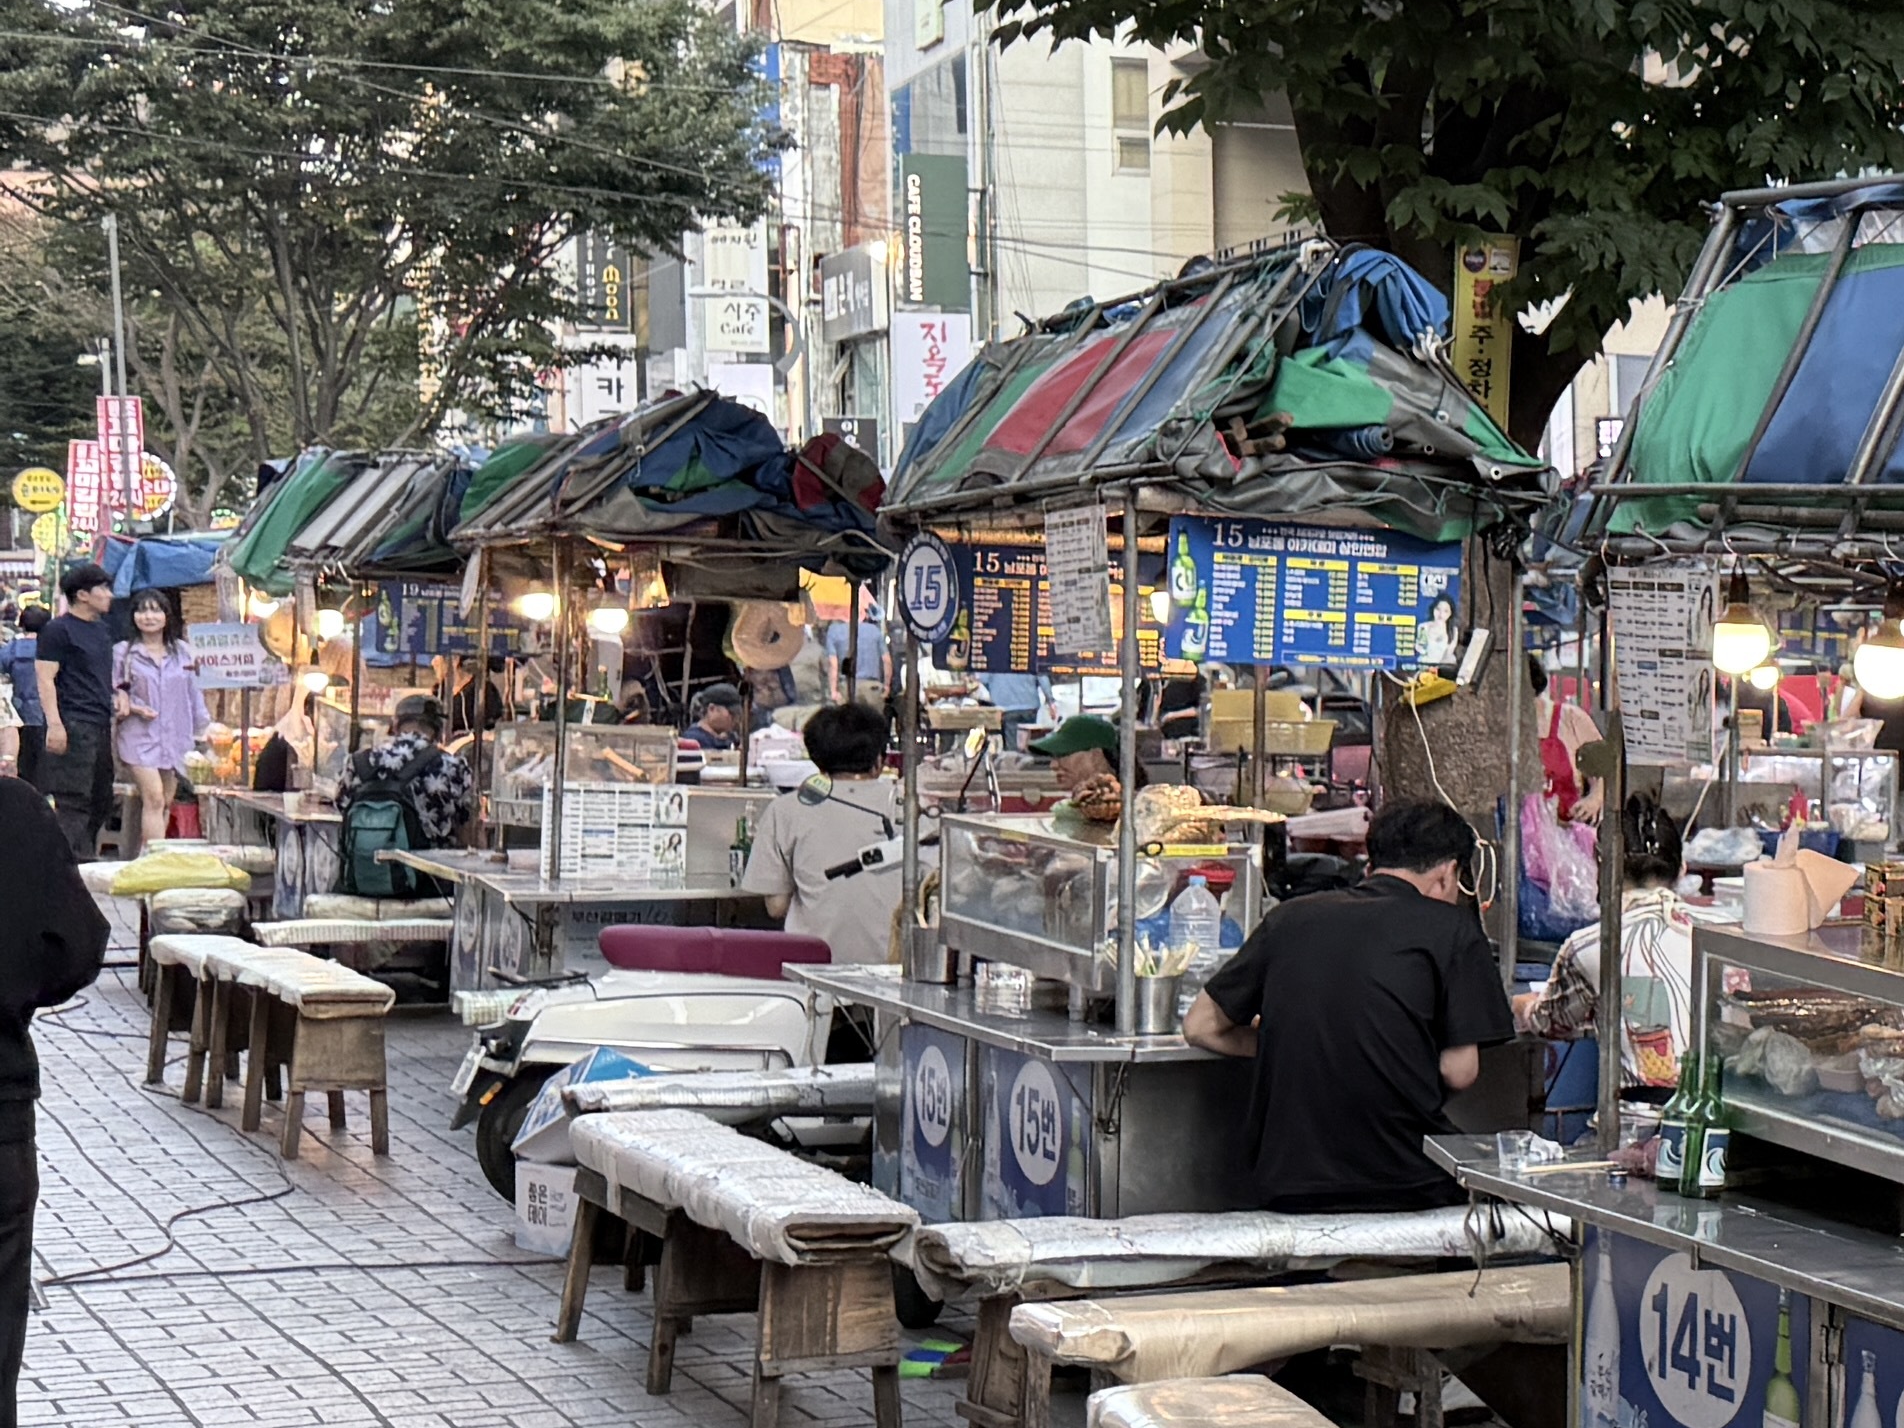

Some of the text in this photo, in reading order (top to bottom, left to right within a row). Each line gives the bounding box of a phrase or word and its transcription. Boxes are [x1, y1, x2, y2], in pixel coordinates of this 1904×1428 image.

[973, 551, 1001, 573] 15
[1212, 523, 1244, 548] 15
[909, 565, 944, 611] 15
[919, 1064, 948, 1128] 15번
[1015, 1083, 1057, 1163] 15번
[1651, 1281, 1737, 1405] 14번
